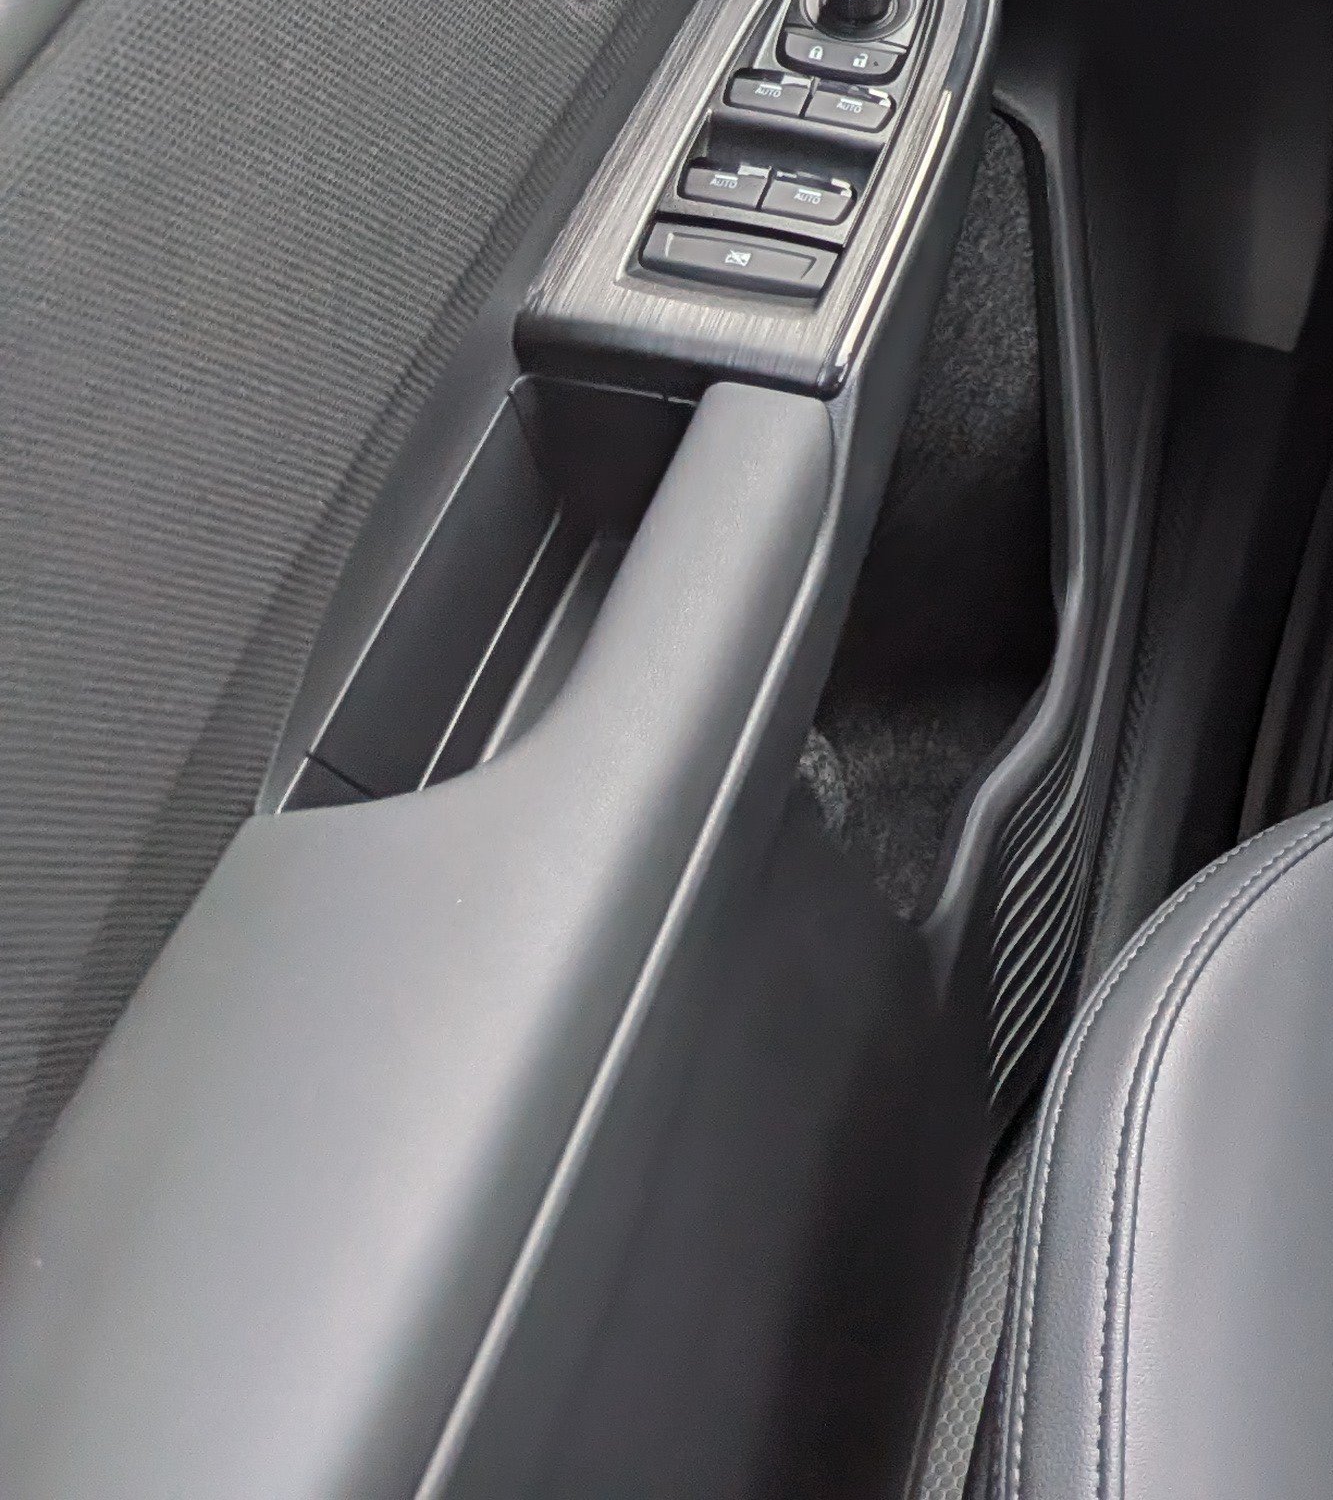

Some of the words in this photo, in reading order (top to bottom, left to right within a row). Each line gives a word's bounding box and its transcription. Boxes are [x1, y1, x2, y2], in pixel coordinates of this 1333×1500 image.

[755, 86, 782, 98] AUTO
[836, 101, 862, 113] AUTO
[710, 178, 737, 189] AUTO
[794, 192, 821, 204] AUTO
